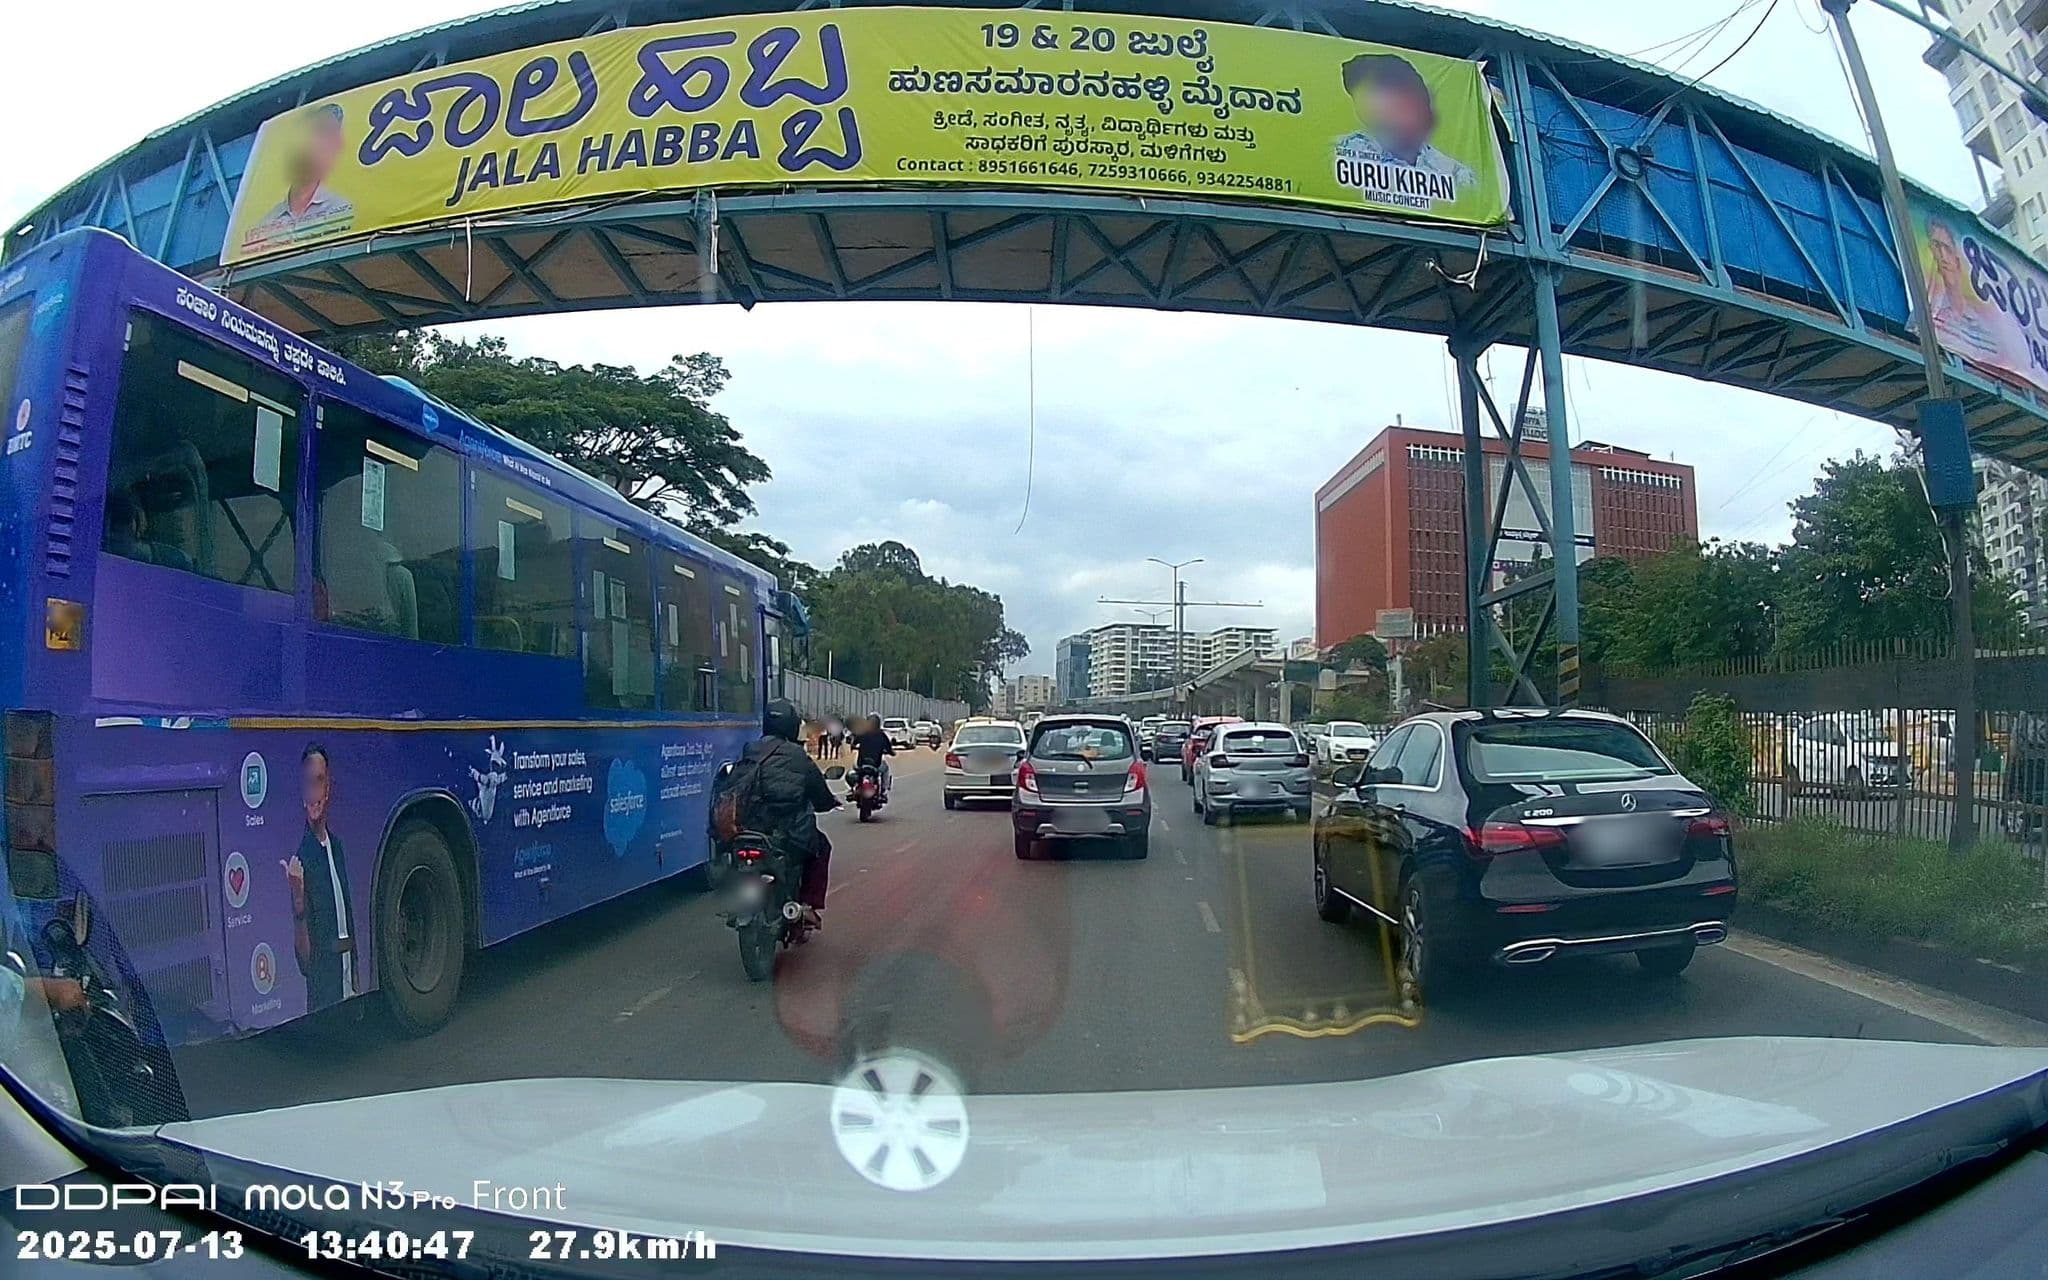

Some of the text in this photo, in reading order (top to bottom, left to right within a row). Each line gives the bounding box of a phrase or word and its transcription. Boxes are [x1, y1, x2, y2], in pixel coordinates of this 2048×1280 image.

[981, 23, 1214, 73] 19 & 20 ಜುಲೈ
[358, 23, 862, 172] ಜಾಲ ಹಬ್ಬ
[1182, 75, 1301, 119] ಮೈದಾನ
[983, 111, 1050, 130] ಸಂಗೀತ,
[1213, 125, 1256, 149] ಮತ್ತು
[446, 119, 761, 207] JALA HABBA
[896, 158, 964, 172] Contact
[978, 160, 1083, 178] 8951661646,
[1088, 163, 1192, 186] 7259310666,
[1197, 171, 1292, 193] 9342254881
[1336, 158, 1455, 201] GURU KIRAN
[1365, 189, 1431, 209] MUSIC CONCERT
[513, 751, 550, 770] Transform
[551, 753, 567, 771] your
[513, 774, 593, 799] service and marketing
[245, 814, 265, 827] Sales
[513, 803, 571, 829] with Agentforce
[227, 913, 252, 928] Service
